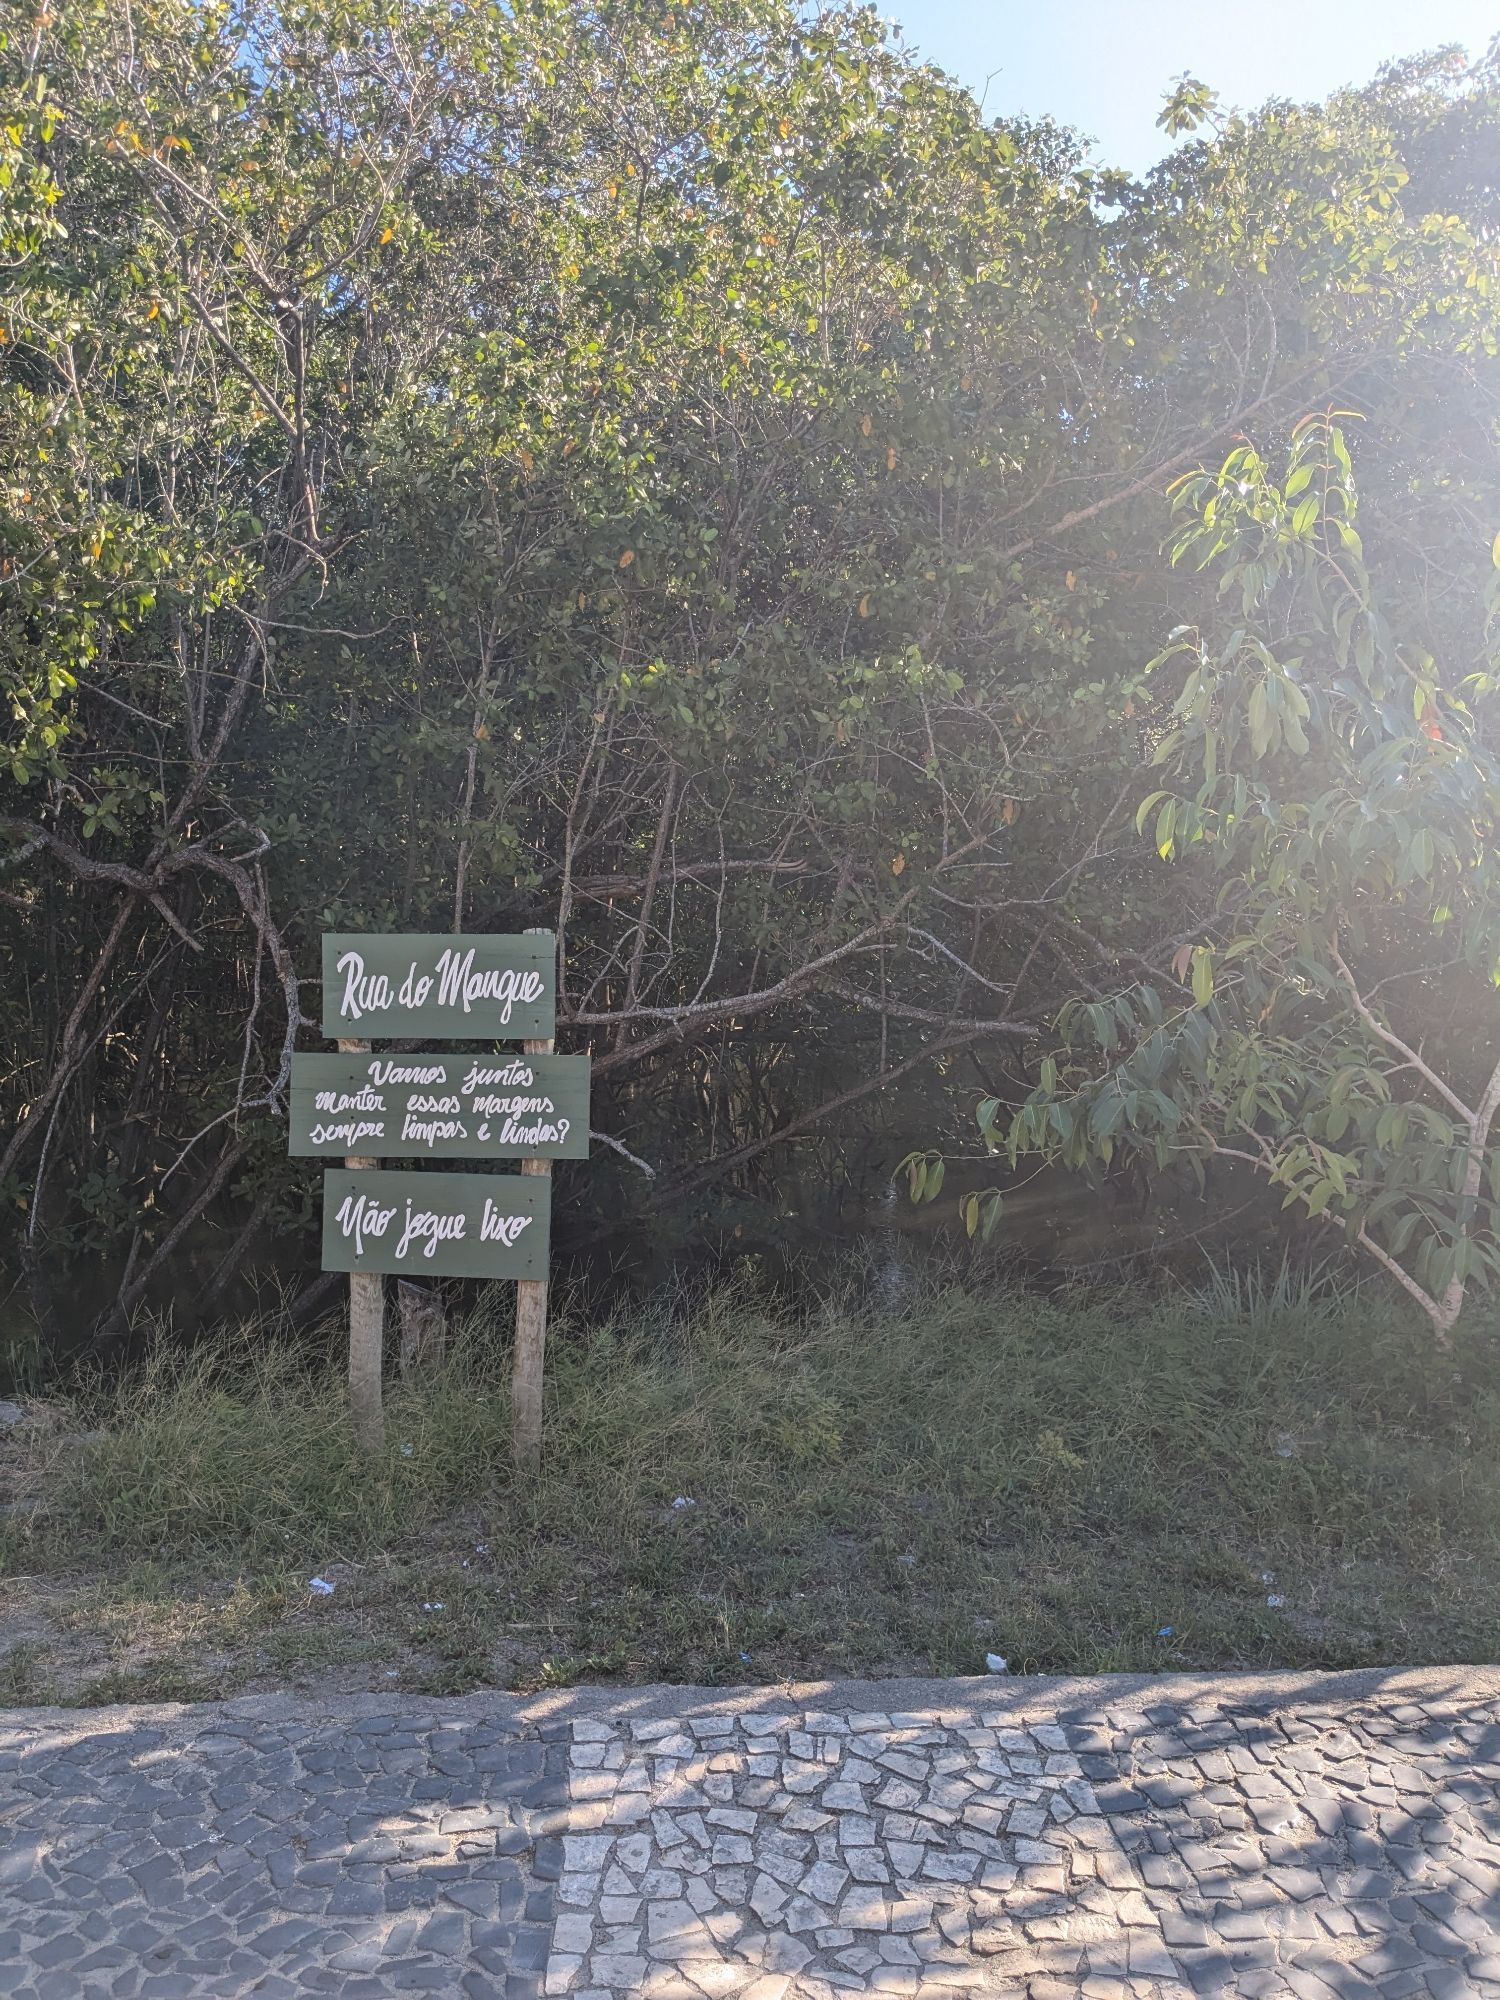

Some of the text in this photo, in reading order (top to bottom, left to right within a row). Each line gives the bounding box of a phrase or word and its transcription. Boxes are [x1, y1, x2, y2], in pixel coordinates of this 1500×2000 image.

[336, 948, 544, 1024] Rua do Mangue
[368, 1059, 534, 1094] Vamos juntos
[406, 1094, 461, 1114] essas
[309, 1114, 571, 1148] sempre limpas e lindas?
[335, 1195, 533, 1259] Não jogue lixo
